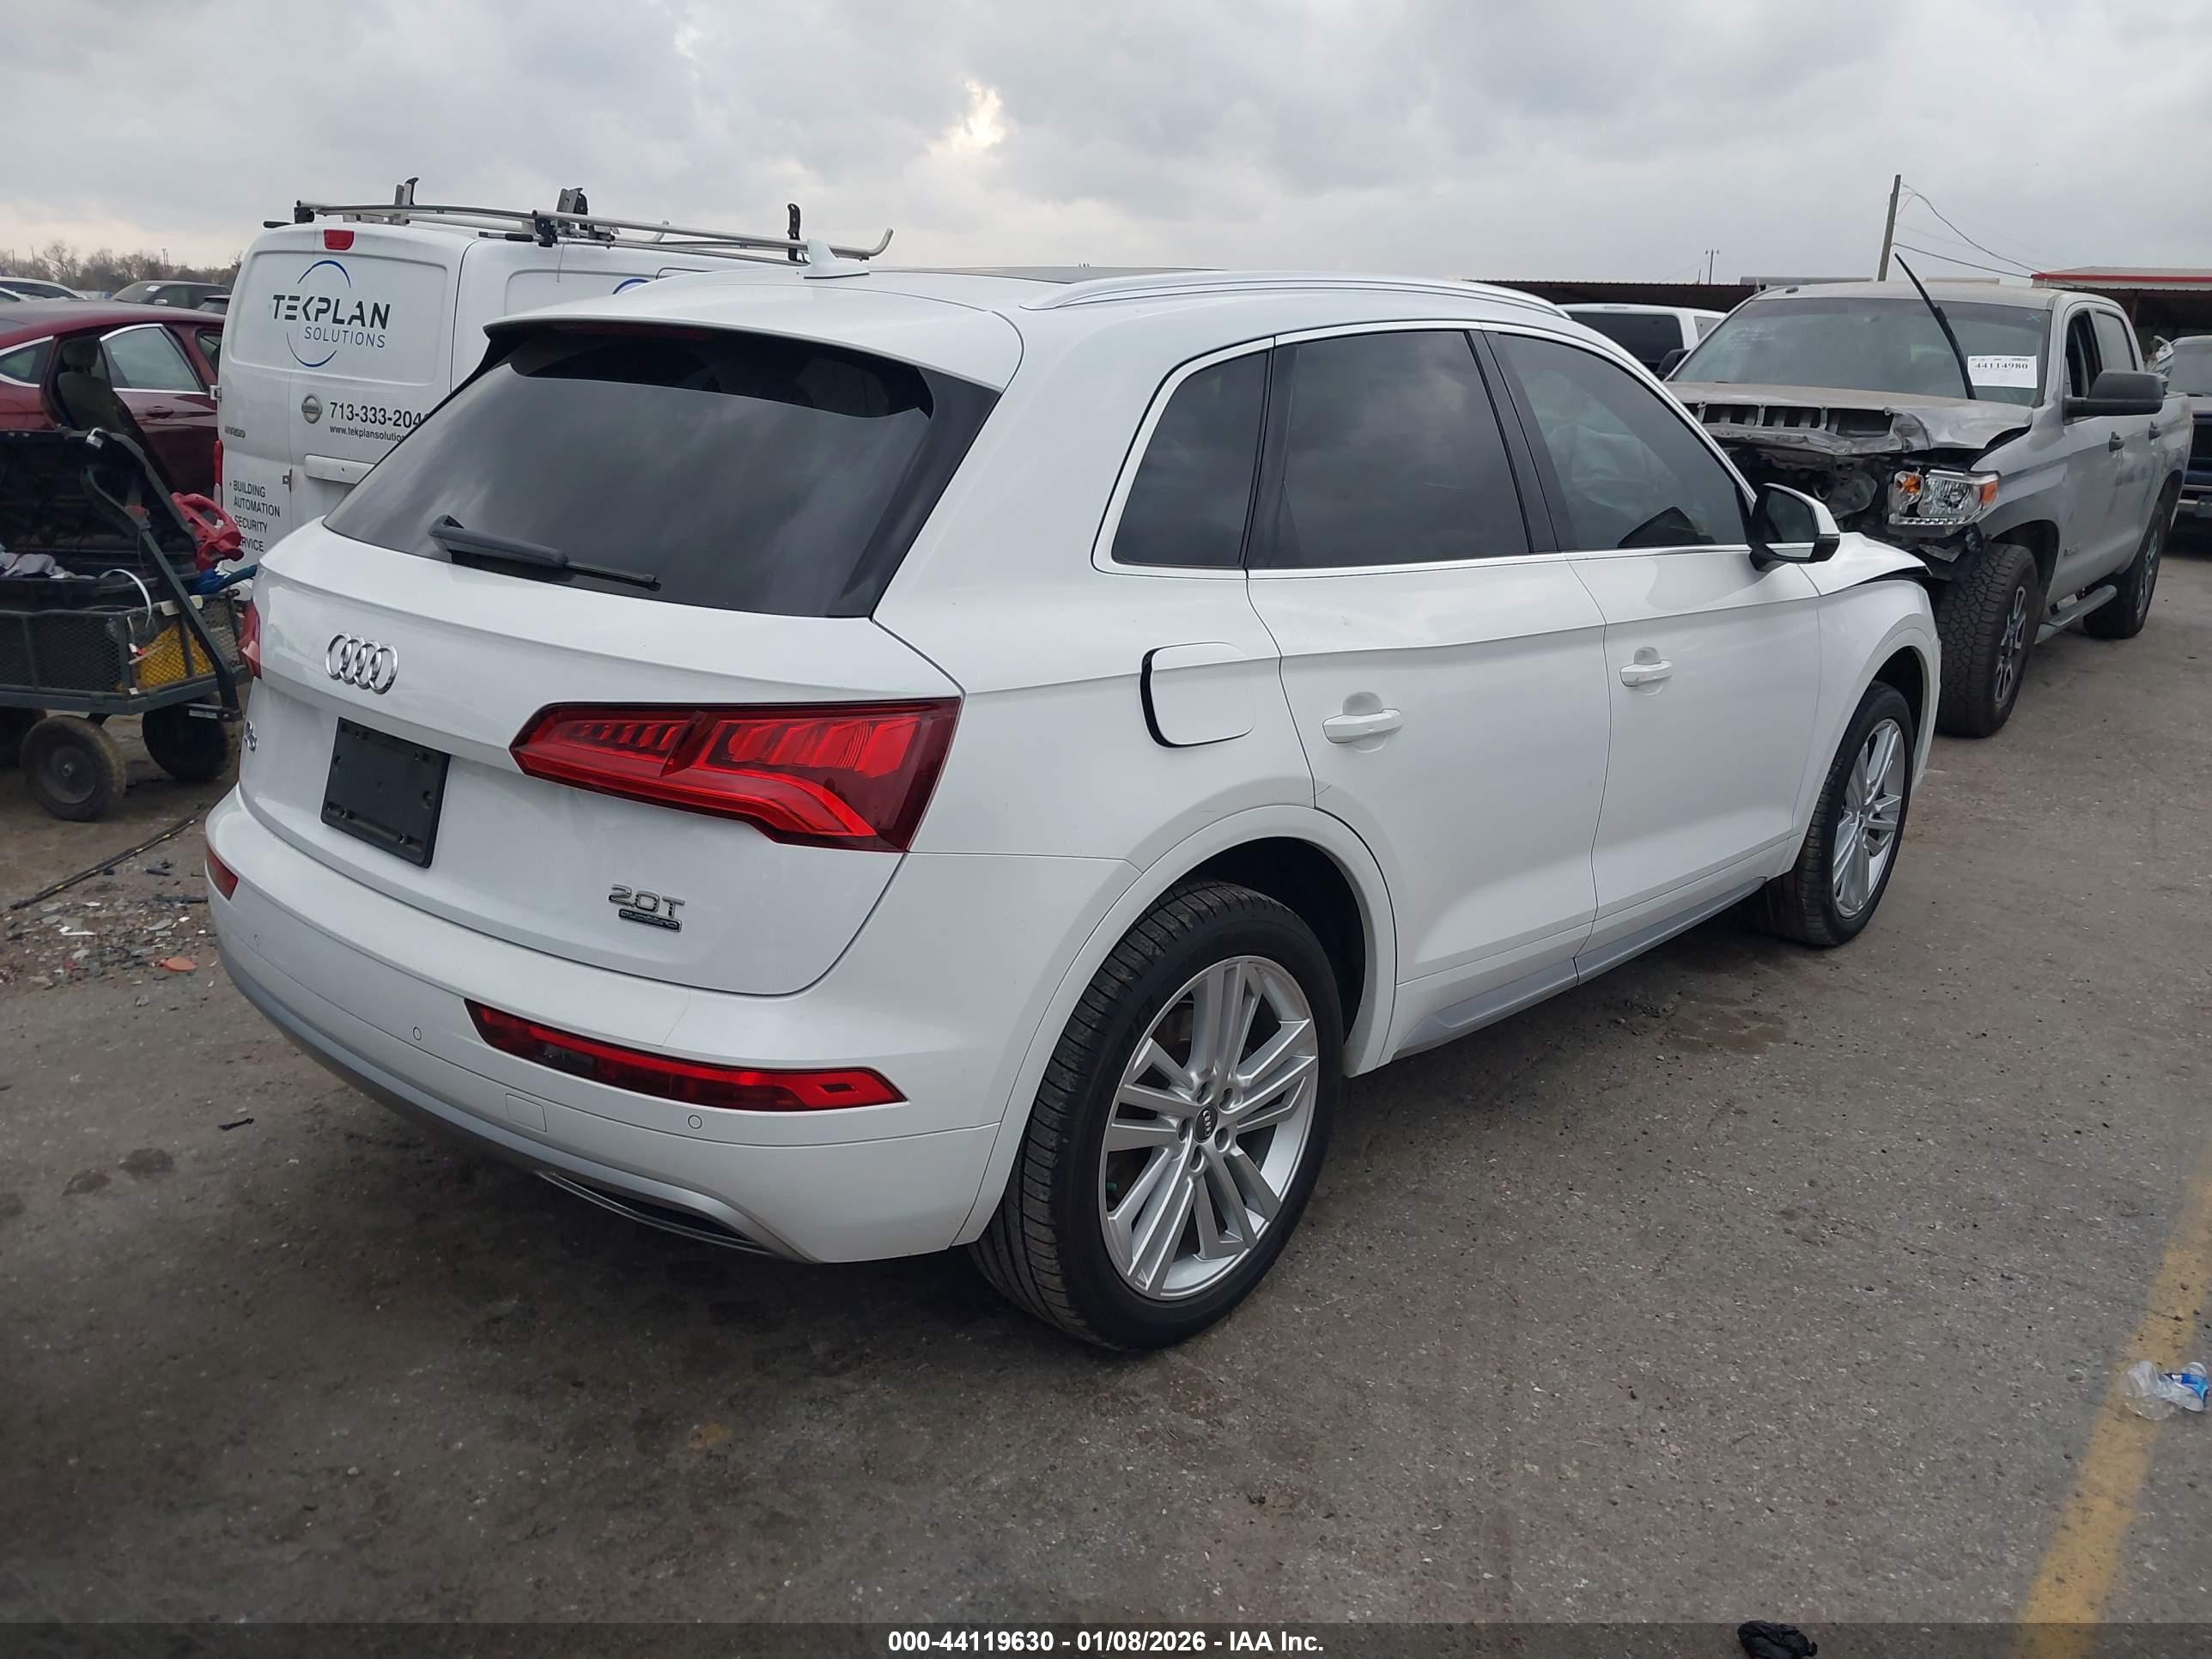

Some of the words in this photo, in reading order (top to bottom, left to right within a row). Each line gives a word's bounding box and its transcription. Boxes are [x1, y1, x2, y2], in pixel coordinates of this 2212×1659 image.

[272, 295, 391, 331] TEKPLAN
[303, 326, 386, 349] SOLUTIONS
[330, 401, 429, 428] 713-333-204
[233, 480, 266, 498] BUILDING
[234, 495, 282, 517] AUTOMATION
[234, 514, 268, 534] SECURITY
[240, 536, 264, 552] RVICE
